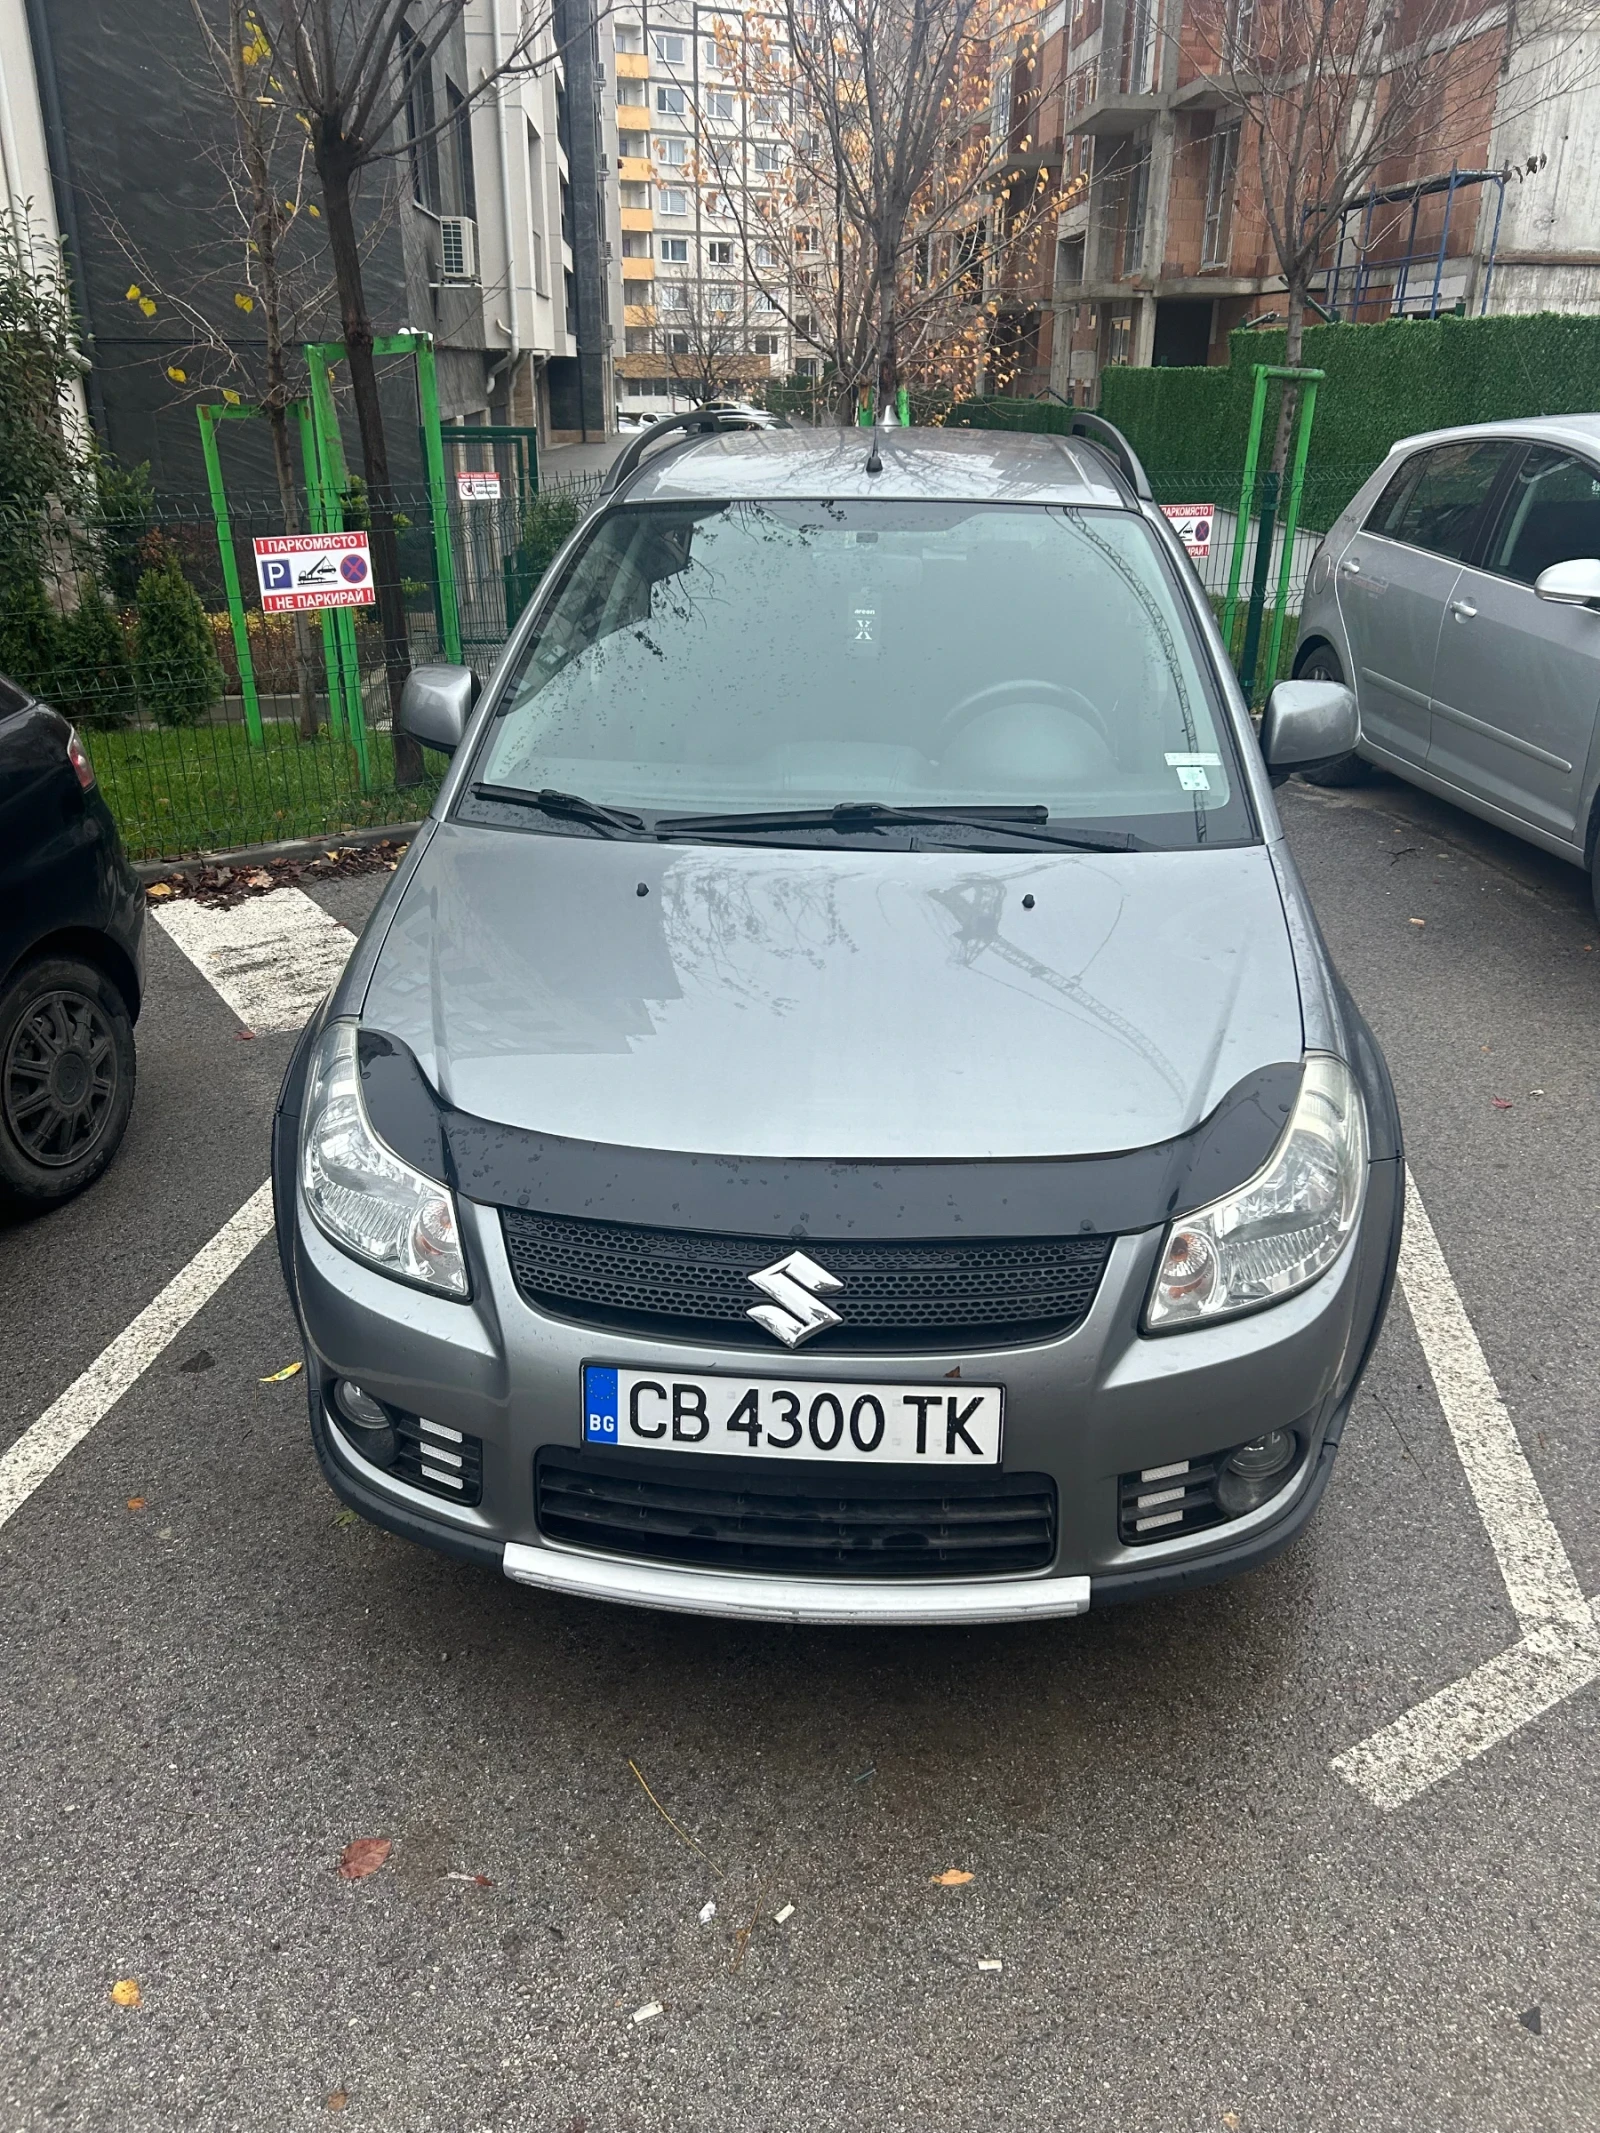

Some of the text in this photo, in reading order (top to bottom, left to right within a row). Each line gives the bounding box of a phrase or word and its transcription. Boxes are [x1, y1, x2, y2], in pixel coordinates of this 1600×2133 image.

[260, 534, 365, 552] ! ПАРКОМЯСТО !
[267, 563, 285, 587] P
[268, 588, 372, 609] ! НЕ ПАРКИРАЙ !
[589, 1414, 614, 1432] BG
[630, 1381, 984, 1455] CB 4300 TK
